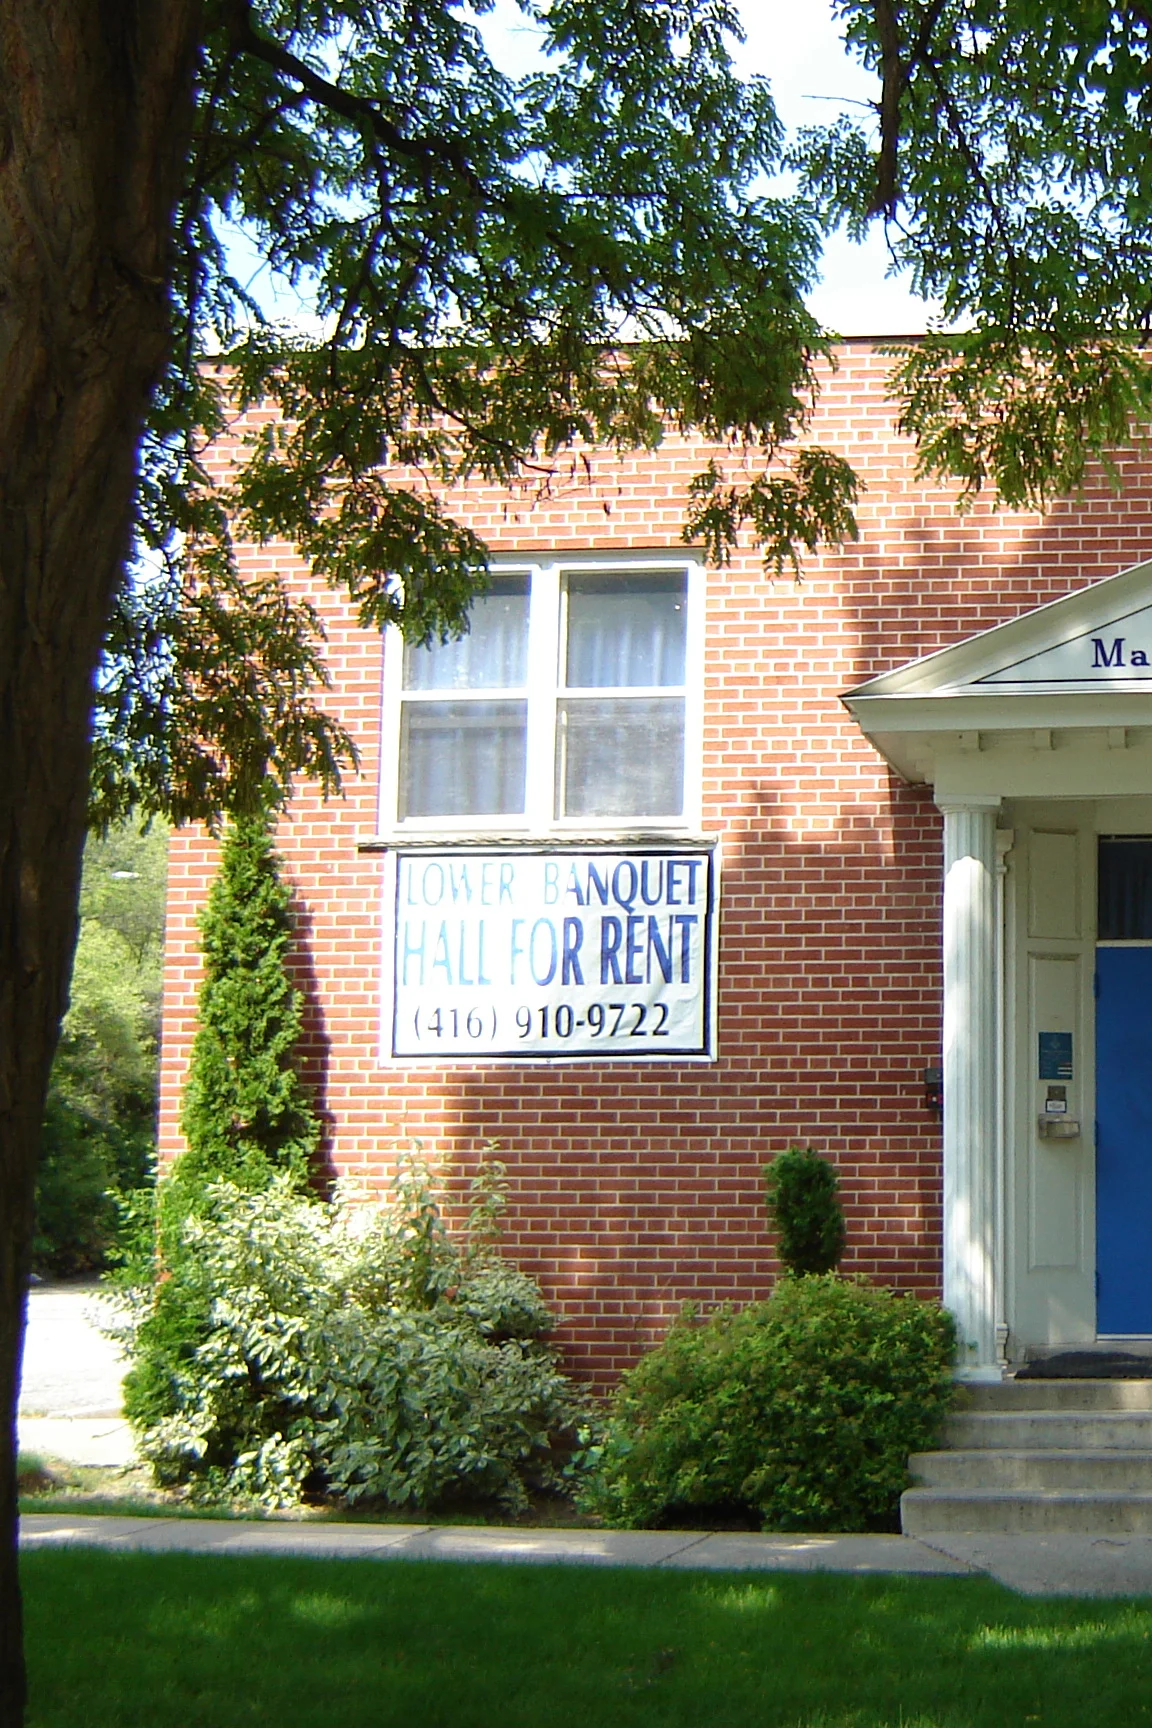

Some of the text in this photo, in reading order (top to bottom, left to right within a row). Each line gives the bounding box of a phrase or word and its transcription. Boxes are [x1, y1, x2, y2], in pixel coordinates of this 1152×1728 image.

[407, 860, 702, 914] LOWER BANQUET
[402, 914, 698, 986] HALL FOR RENT
[414, 1003, 669, 1041] (416) 910-9722
